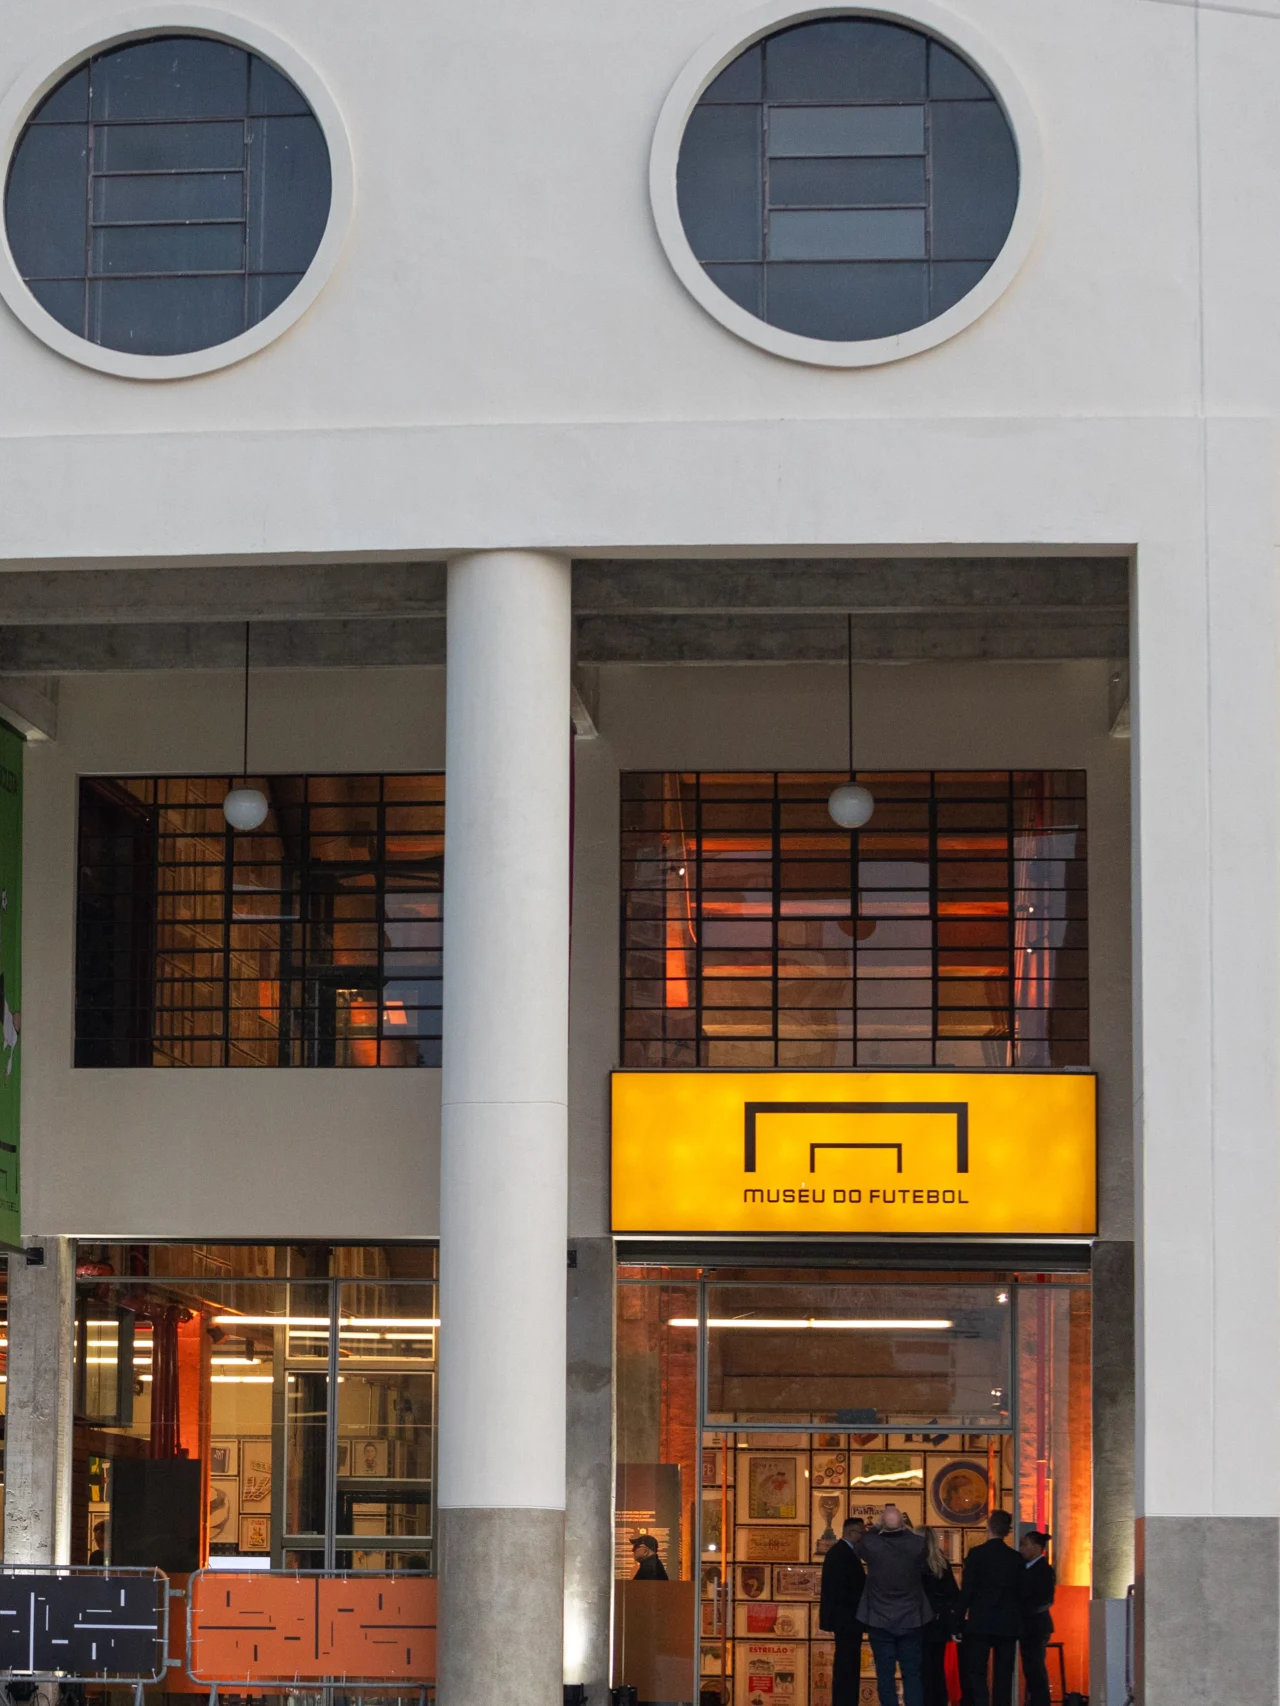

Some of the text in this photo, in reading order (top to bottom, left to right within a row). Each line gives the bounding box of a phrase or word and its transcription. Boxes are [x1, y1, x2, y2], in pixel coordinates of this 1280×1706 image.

[743, 1189, 969, 1204] MUSEU DO FUTEBOL
